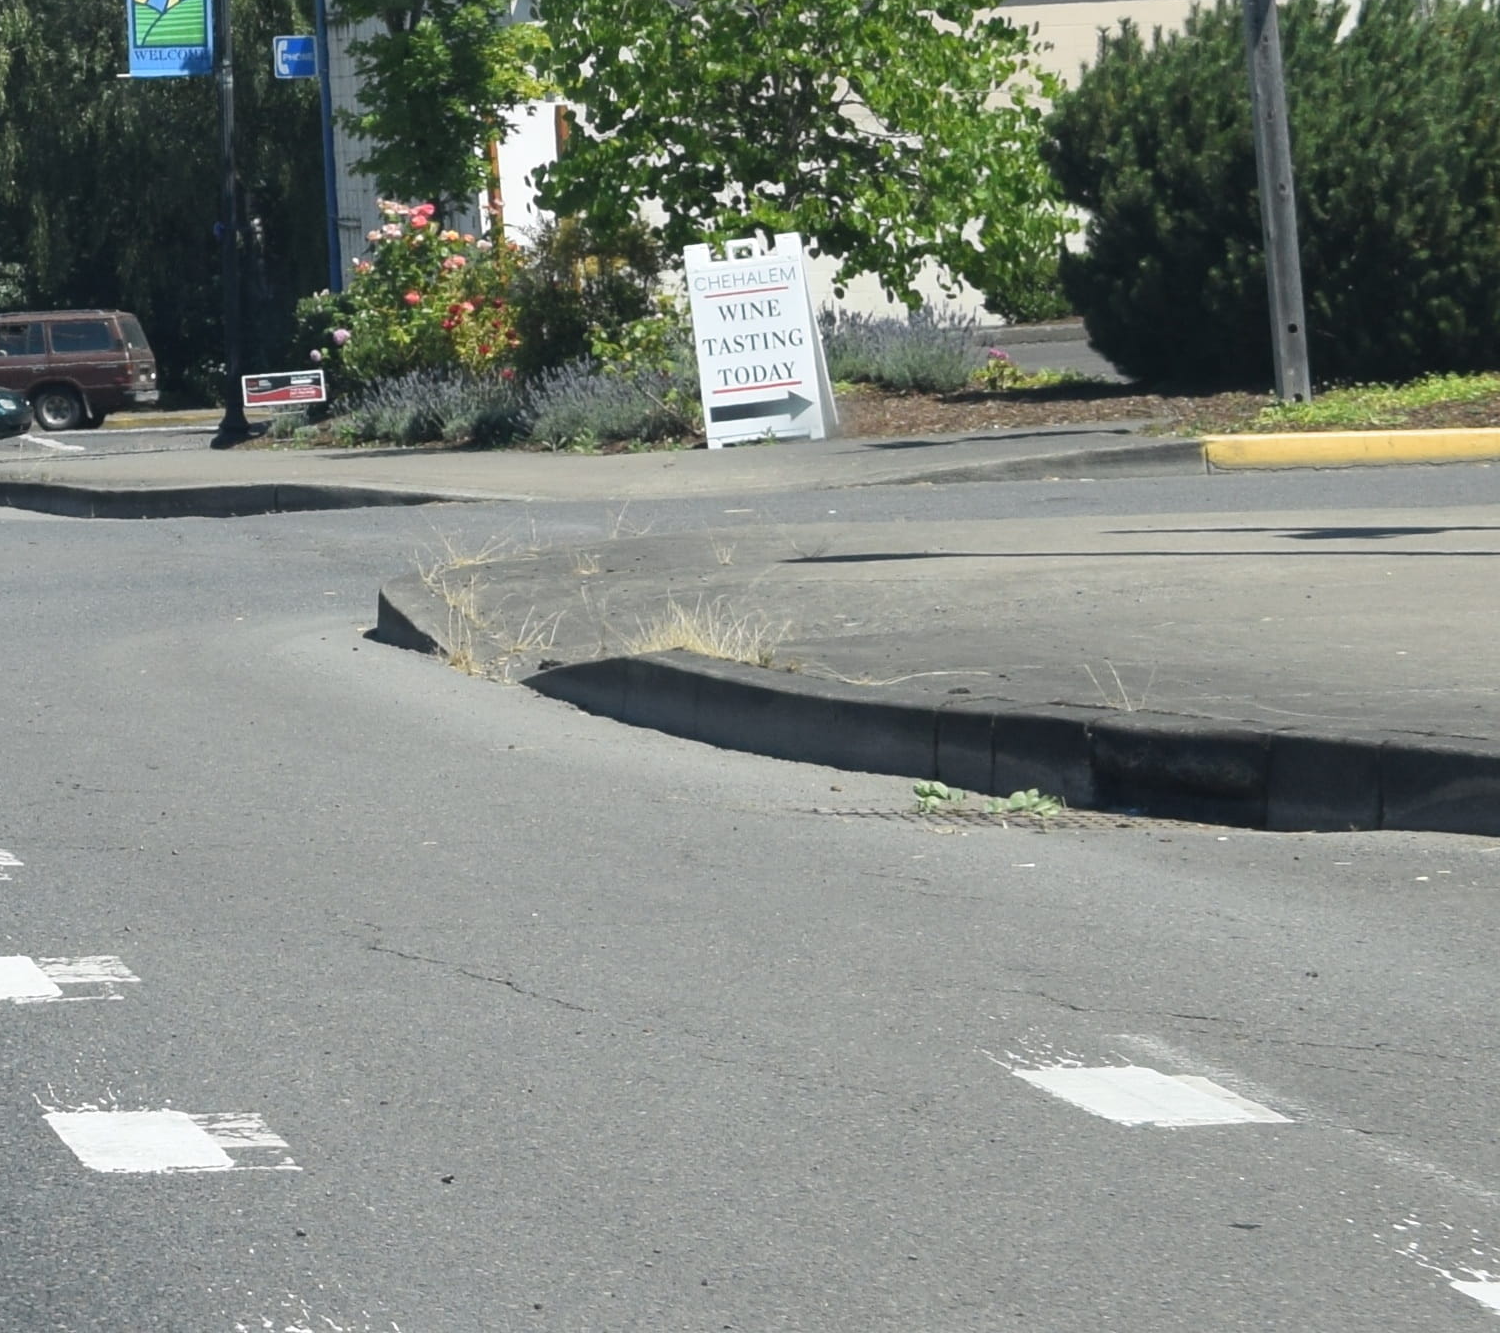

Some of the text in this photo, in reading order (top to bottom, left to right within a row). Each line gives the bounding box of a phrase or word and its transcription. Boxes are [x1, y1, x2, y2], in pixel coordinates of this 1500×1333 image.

[694, 266, 797, 292] CHEHALEM
[718, 299, 781, 322] WINE
[702, 328, 804, 357] TASTING
[717, 361, 795, 386] TODAY
